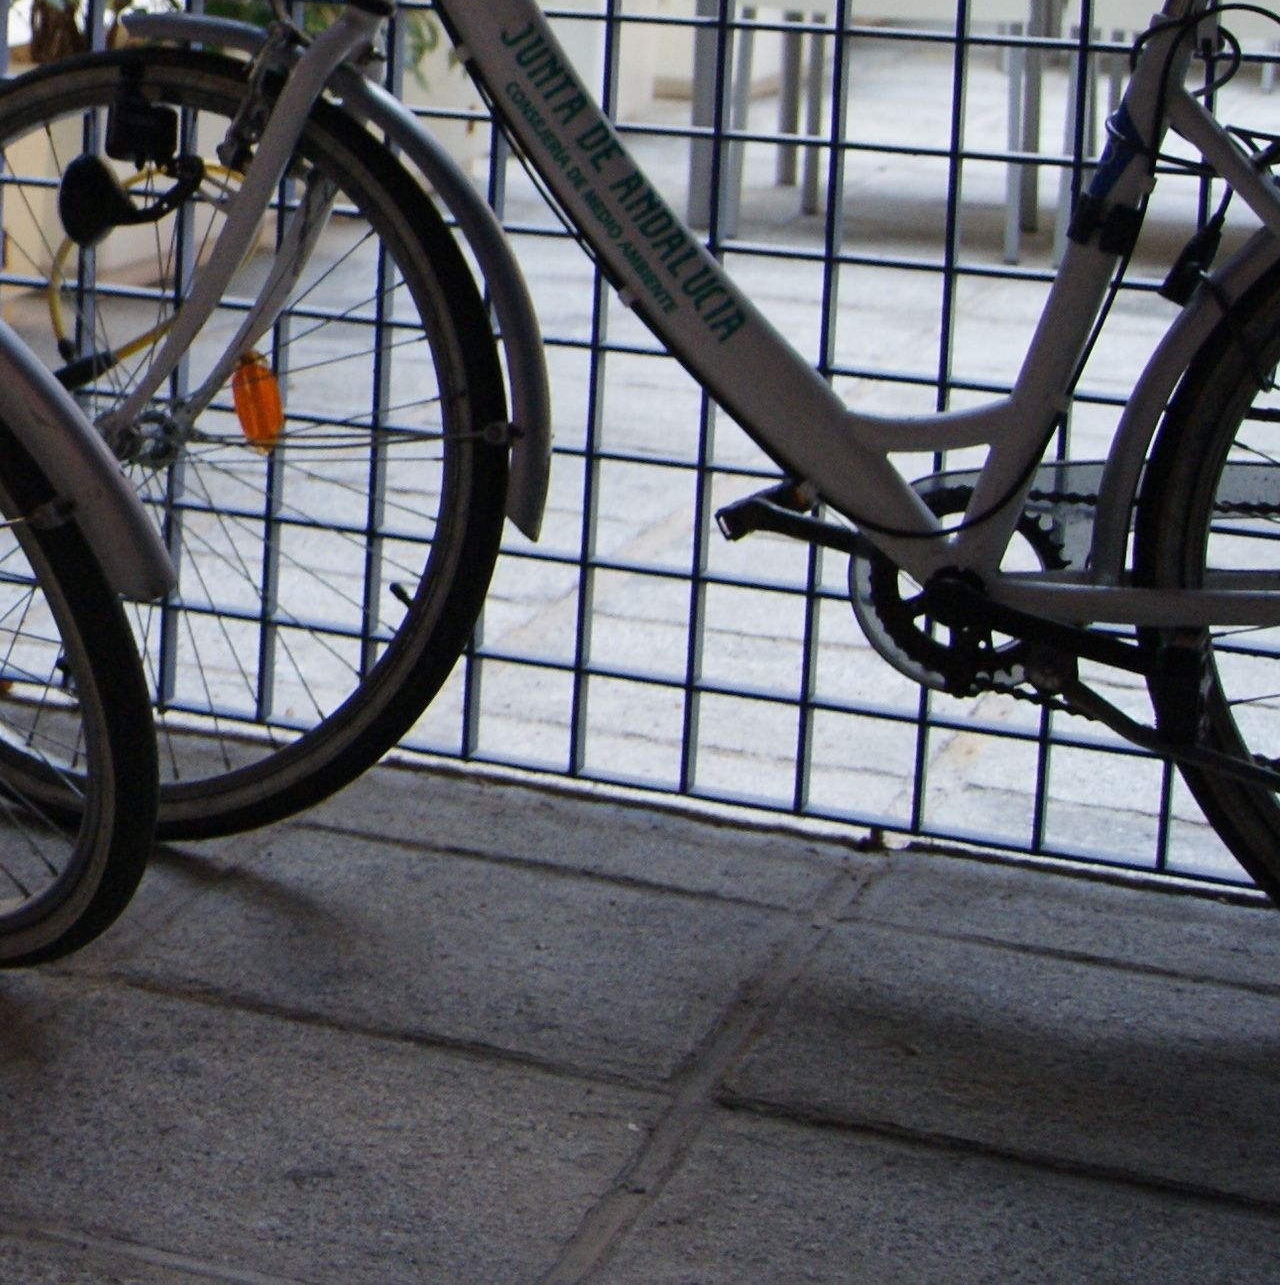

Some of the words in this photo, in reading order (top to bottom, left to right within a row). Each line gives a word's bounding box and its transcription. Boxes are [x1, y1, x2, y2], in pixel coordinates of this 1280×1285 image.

[501, 22, 589, 125] JUNTA
[575, 115, 628, 174] DE
[565, 165, 588, 192] DE
[584, 188, 623, 239] MEDIO
[619, 242, 680, 314] AMBIENTE
